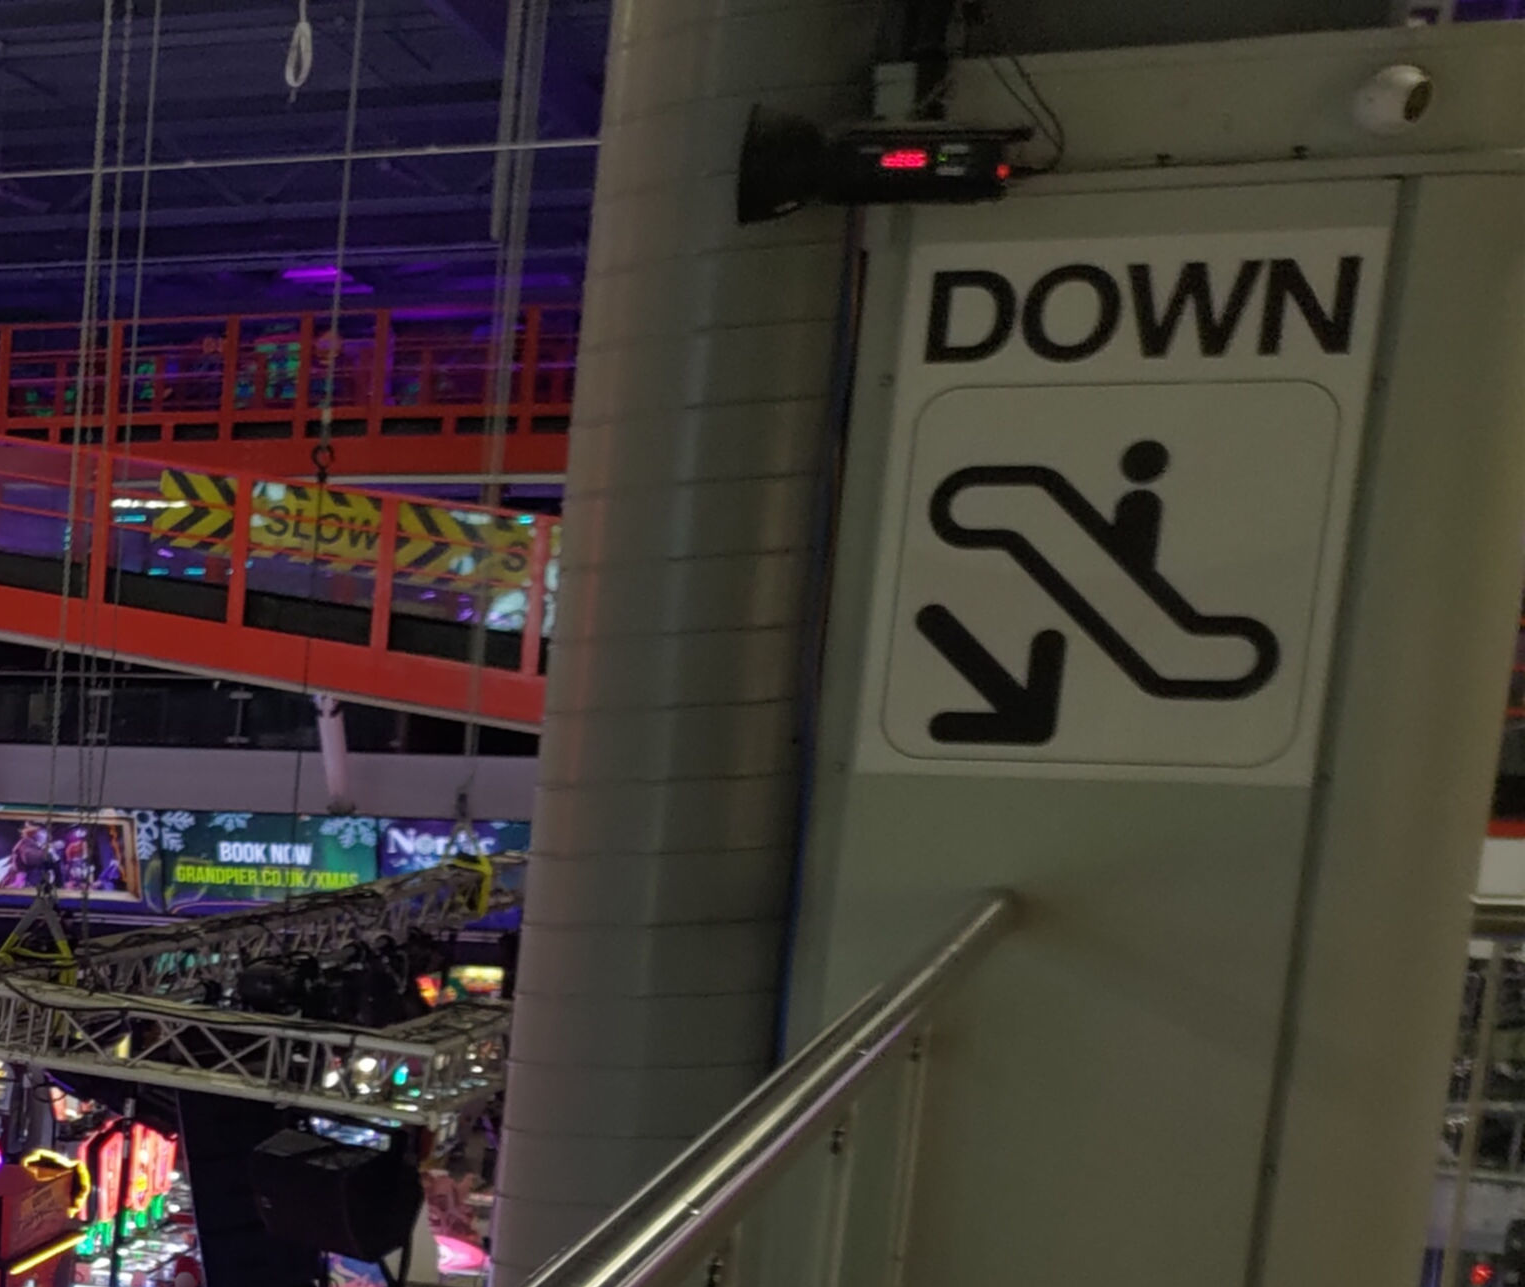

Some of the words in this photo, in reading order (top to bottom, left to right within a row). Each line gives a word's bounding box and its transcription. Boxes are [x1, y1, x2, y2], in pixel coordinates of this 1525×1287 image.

[924, 255, 1362, 364] DOWN
[264, 503, 380, 548] SLOW
[219, 840, 265, 864] BOOK
[270, 842, 312, 866] NOW
